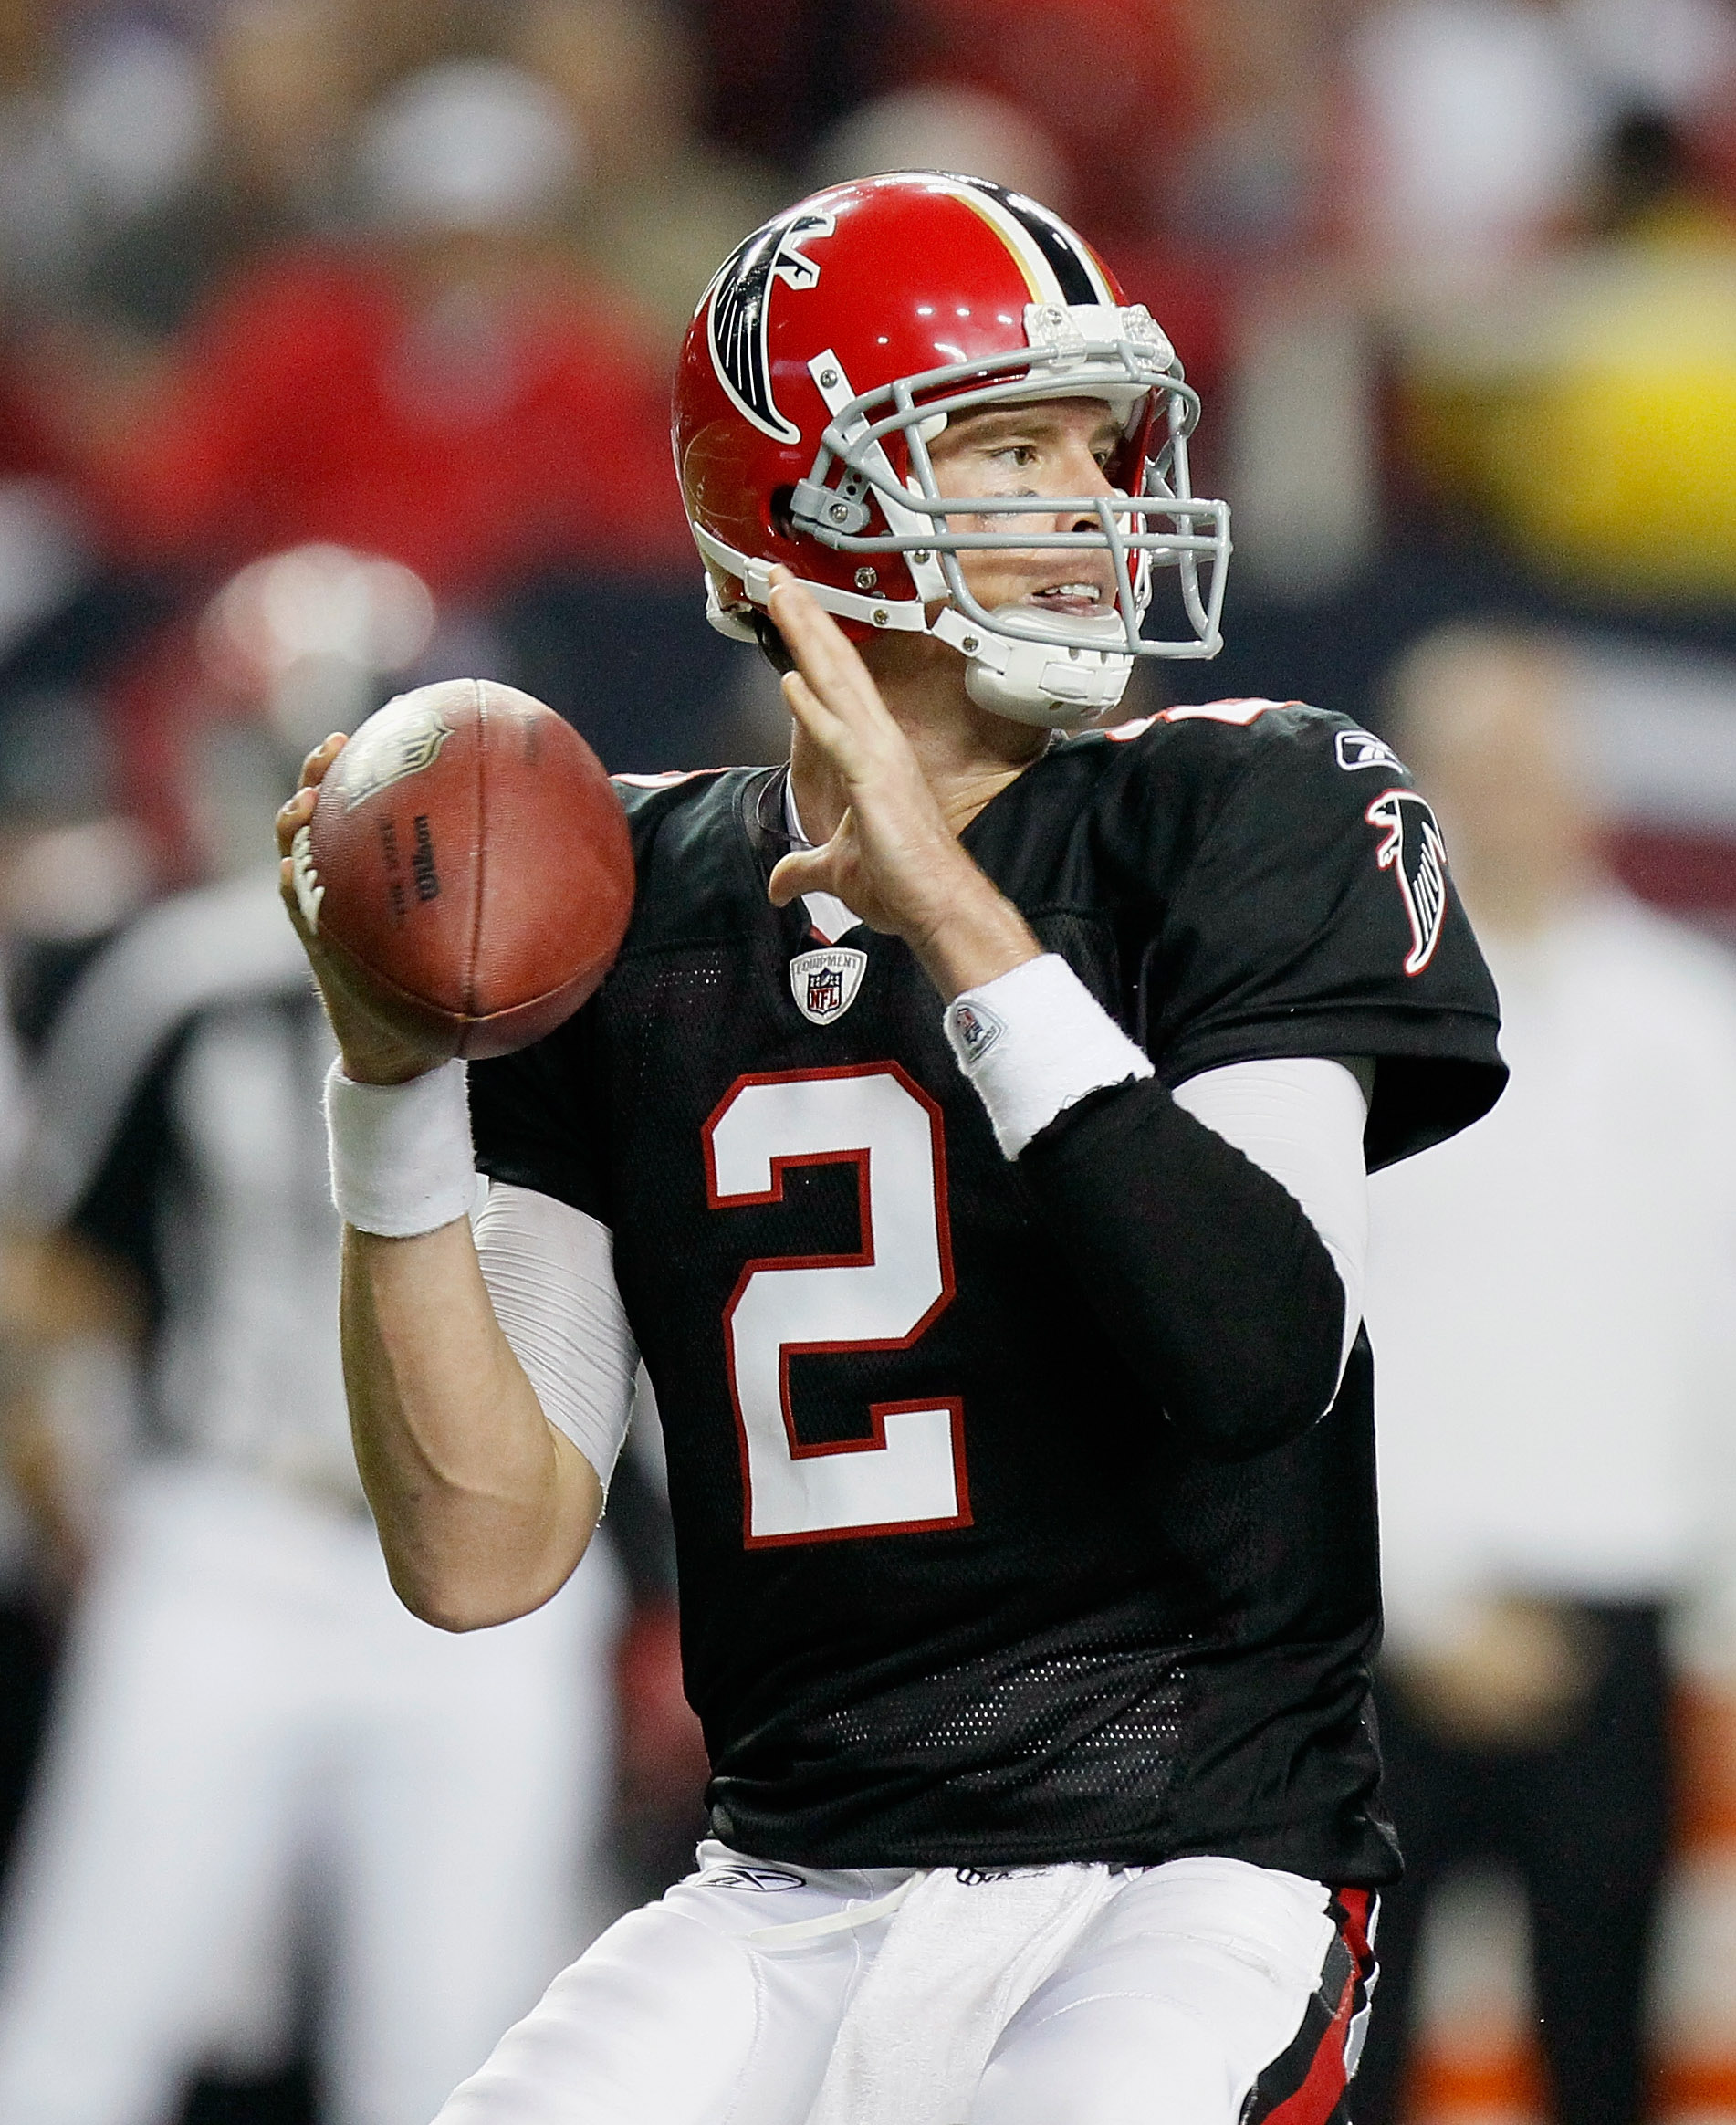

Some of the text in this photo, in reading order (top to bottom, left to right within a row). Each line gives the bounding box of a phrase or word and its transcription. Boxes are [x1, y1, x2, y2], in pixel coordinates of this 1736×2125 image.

[413, 815, 440, 901] Wilson
[796, 955, 856, 974] EQUIPMENT
[809, 989, 839, 1010] NFL
[701, 1061, 974, 1549] 2
